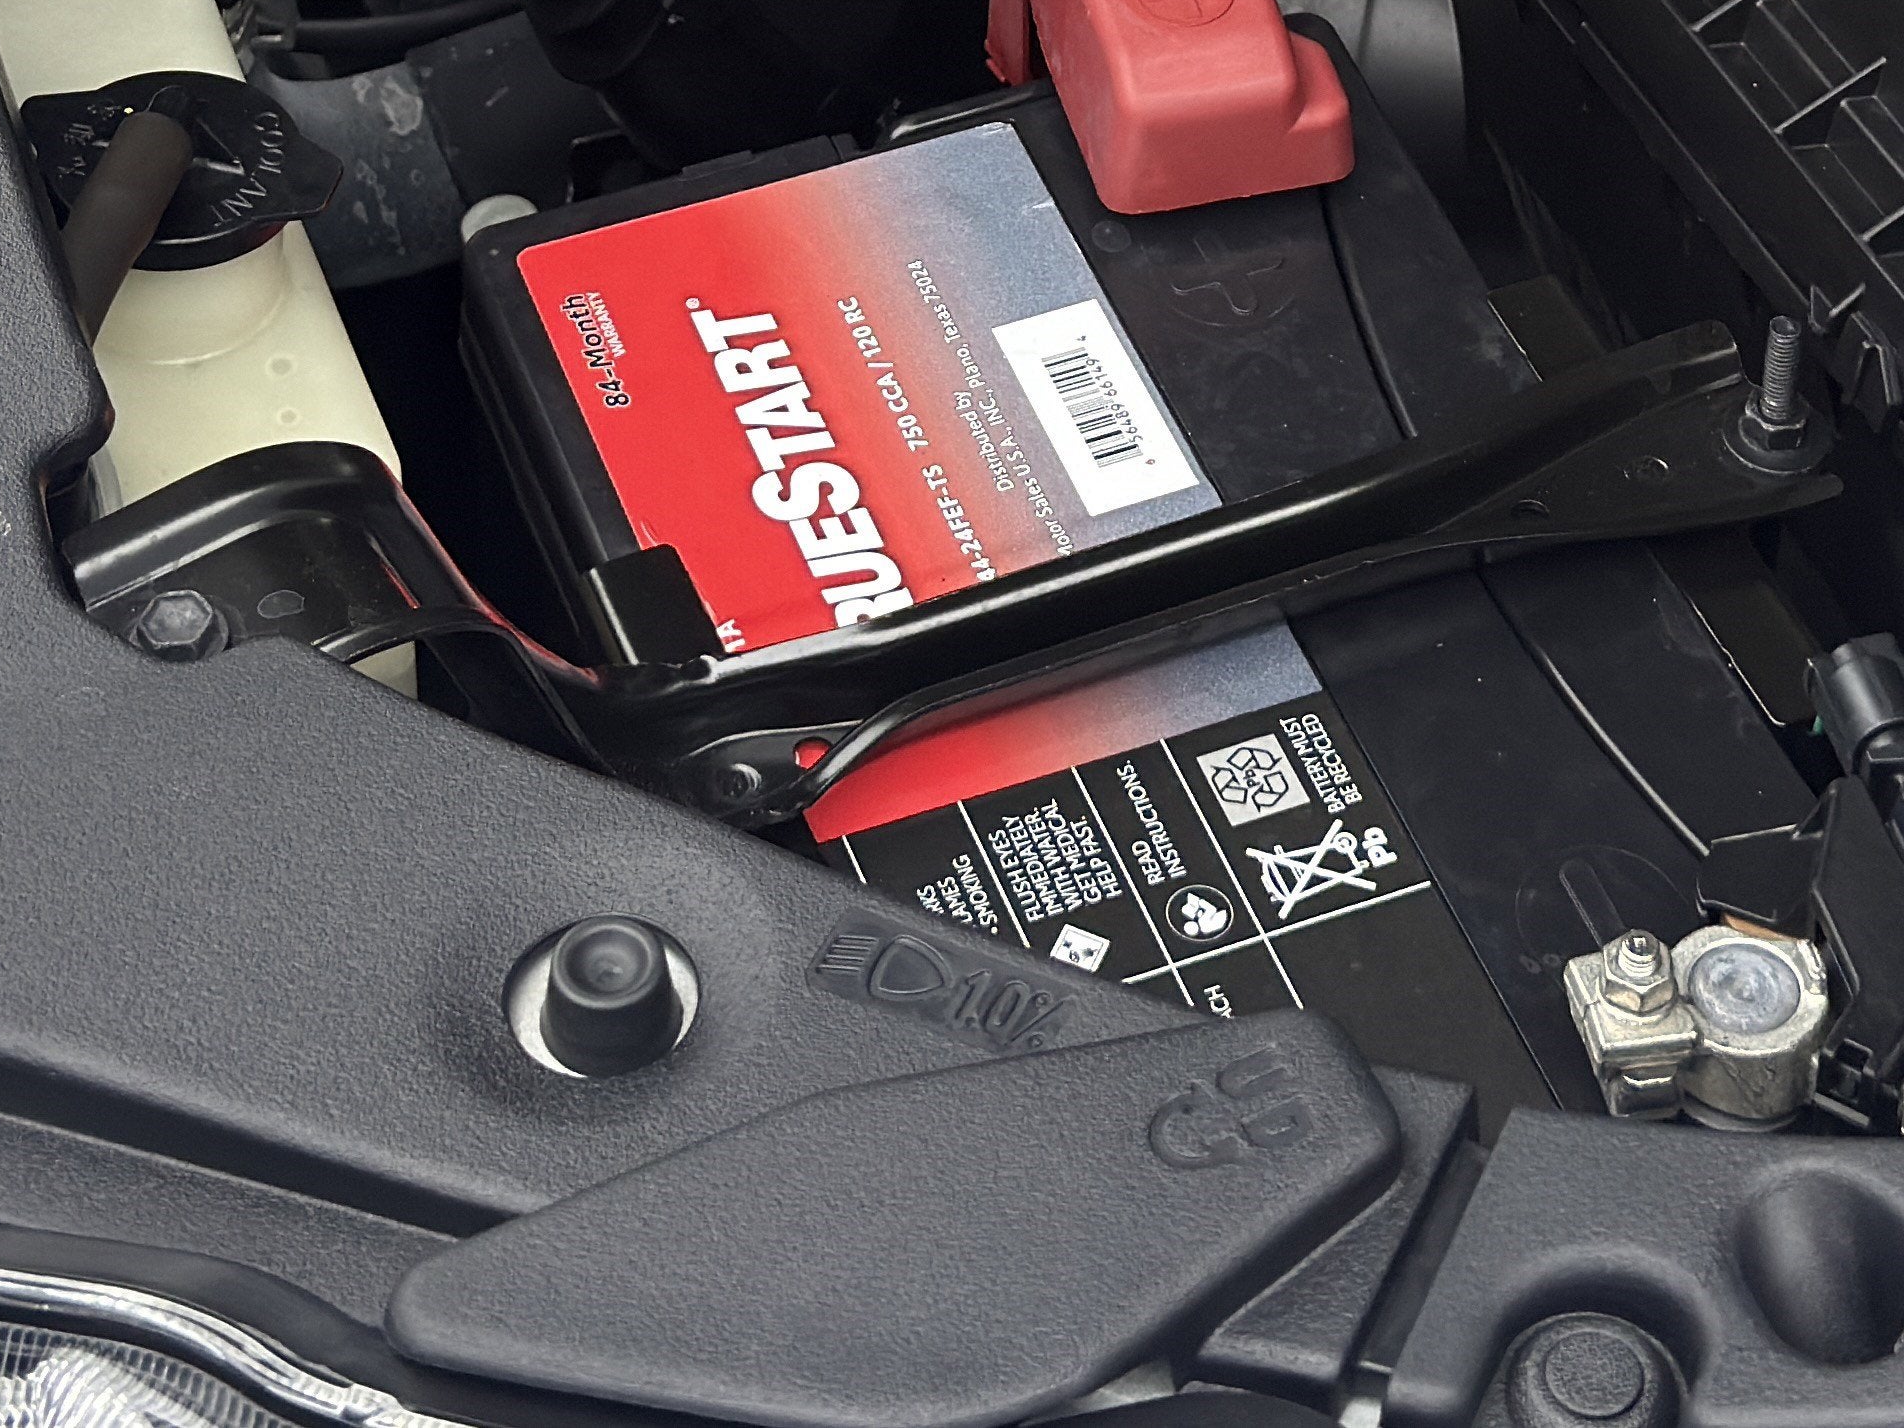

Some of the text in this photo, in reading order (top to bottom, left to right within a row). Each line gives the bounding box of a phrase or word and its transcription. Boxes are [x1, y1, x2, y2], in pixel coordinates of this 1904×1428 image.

[212, 110, 285, 229] COOLANT
[837, 296, 866, 325] RC
[907, 260, 941, 304] 75024
[560, 293, 631, 408] 84-Month
[585, 292, 627, 358] WARRANTY
[852, 325, 882, 358] 120
[933, 304, 961, 344] Texas
[876, 371, 909, 413] CCA
[956, 343, 986, 388] Plano,
[896, 414, 929, 452] 750
[954, 391, 1015, 492] Distributed by
[978, 388, 1005, 427] INC.,
[690, 308, 914, 629] RUESTART
[1024, 477, 1053, 518] Sales
[1244, 768, 1260, 789] Pb
[1279, 717, 1346, 814] BATTERY MUST
[1301, 713, 1363, 805] BE RECYCLED
[1041, 797, 1102, 902] GET MEDICAL
[1116, 759, 1187, 879] INSTRUCTIONS.
[1361, 826, 1397, 868] Pb
[952, 854, 998, 926] SMOKING
[988, 829, 1044, 922] FLUSH EYES
[1002, 816, 1065, 917] IMMEDIATELY
[1024, 807, 1083, 913] WITH WATER.
[1070, 815, 1123, 898] HELP FAST.
[1131, 840, 1165, 886] READ
[937, 876, 974, 924] LAMES
[953, 968, 1078, 1049] 1.0%
